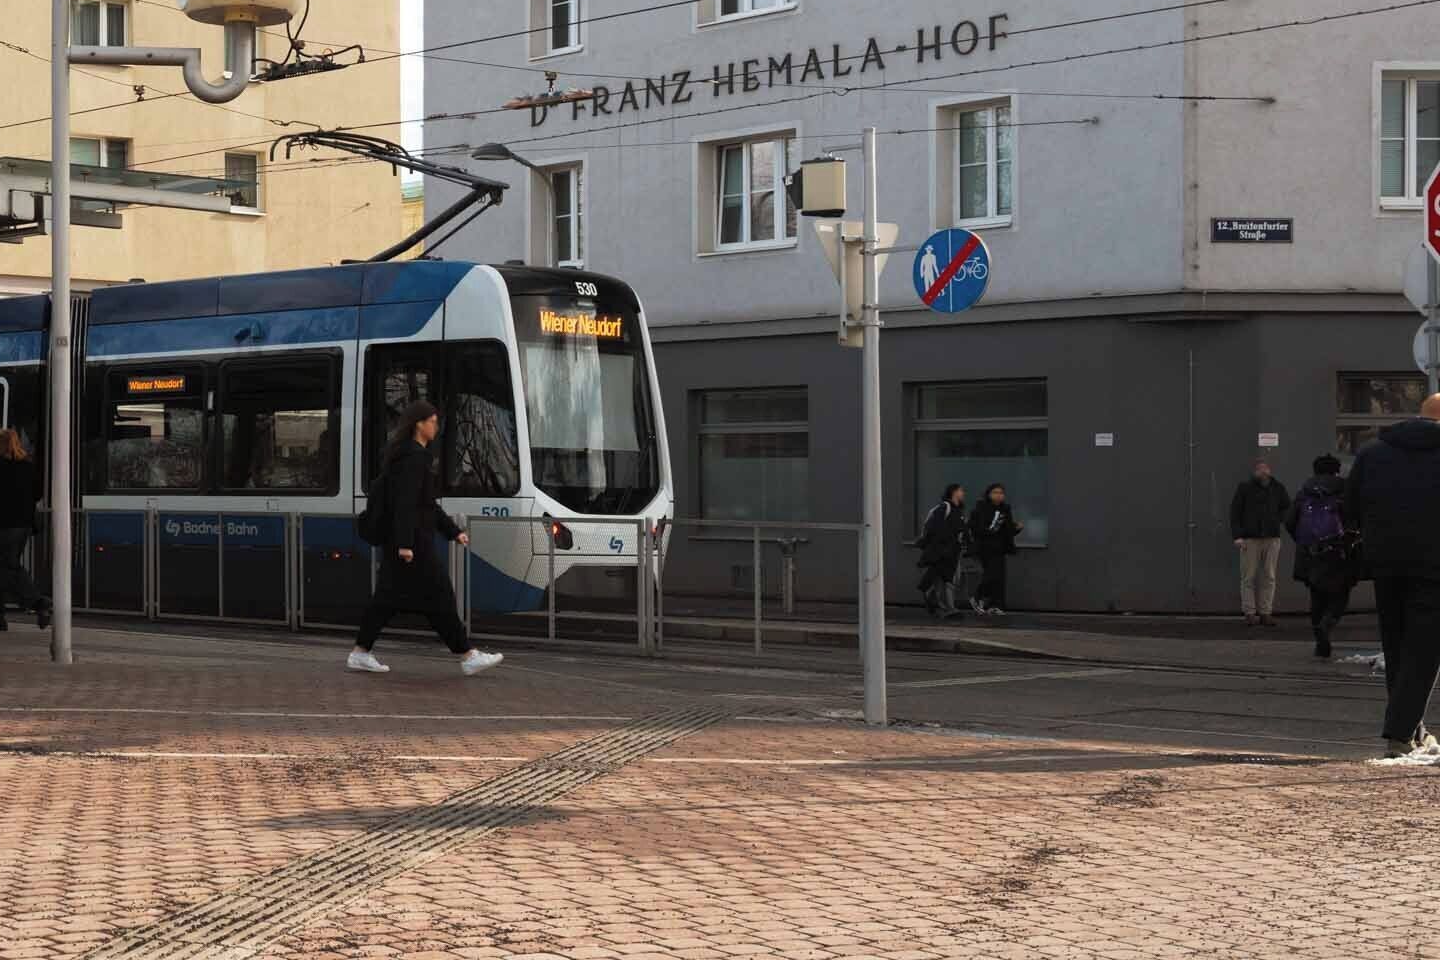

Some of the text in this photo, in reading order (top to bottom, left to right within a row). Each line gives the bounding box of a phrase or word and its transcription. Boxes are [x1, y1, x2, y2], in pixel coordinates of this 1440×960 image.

[571, 70, 694, 121] FRANZ
[1232, 221, 1289, 231] Breitenfurter
[1239, 230, 1266, 240] Straße
[575, 281, 598, 296] 530
[540, 310, 622, 337] Wiener Neudorf
[129, 378, 185, 390] Wiener Neudorf
[481, 506, 509, 518] 530
[227, 522, 258, 536] Bahn
